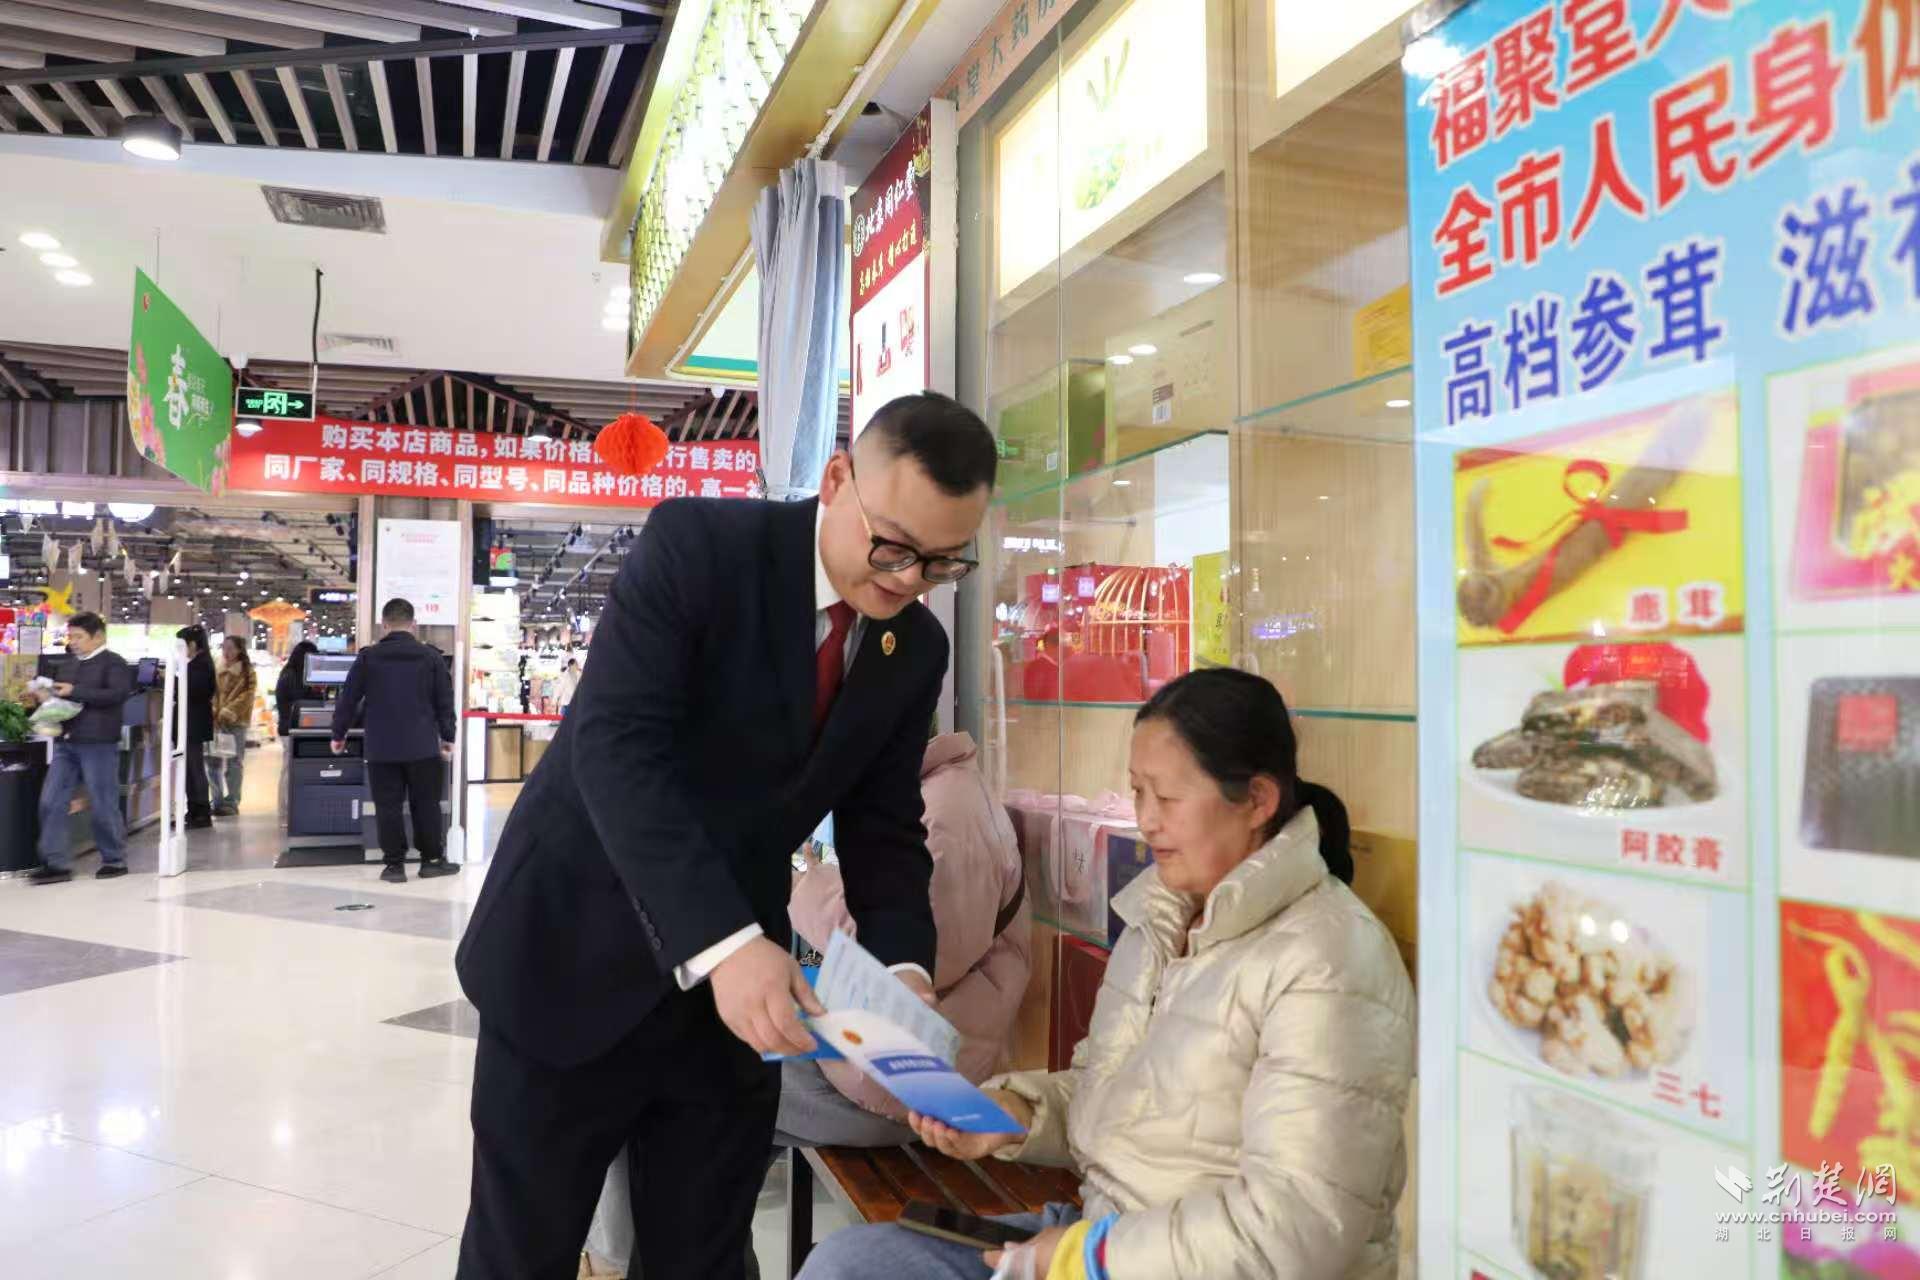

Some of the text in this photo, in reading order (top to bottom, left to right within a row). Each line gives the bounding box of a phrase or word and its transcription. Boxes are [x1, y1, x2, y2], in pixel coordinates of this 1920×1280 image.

[1432, 0, 1730, 168] 福聚堂
[1445, 243, 1721, 425] 高档参茸
[163, 344, 189, 431] 春
[322, 424, 757, 472] 购买本店商品，如果价格行售卖的
[1621, 829, 1722, 871] 阿胶膏
[1652, 1071, 1722, 1119] 三七
